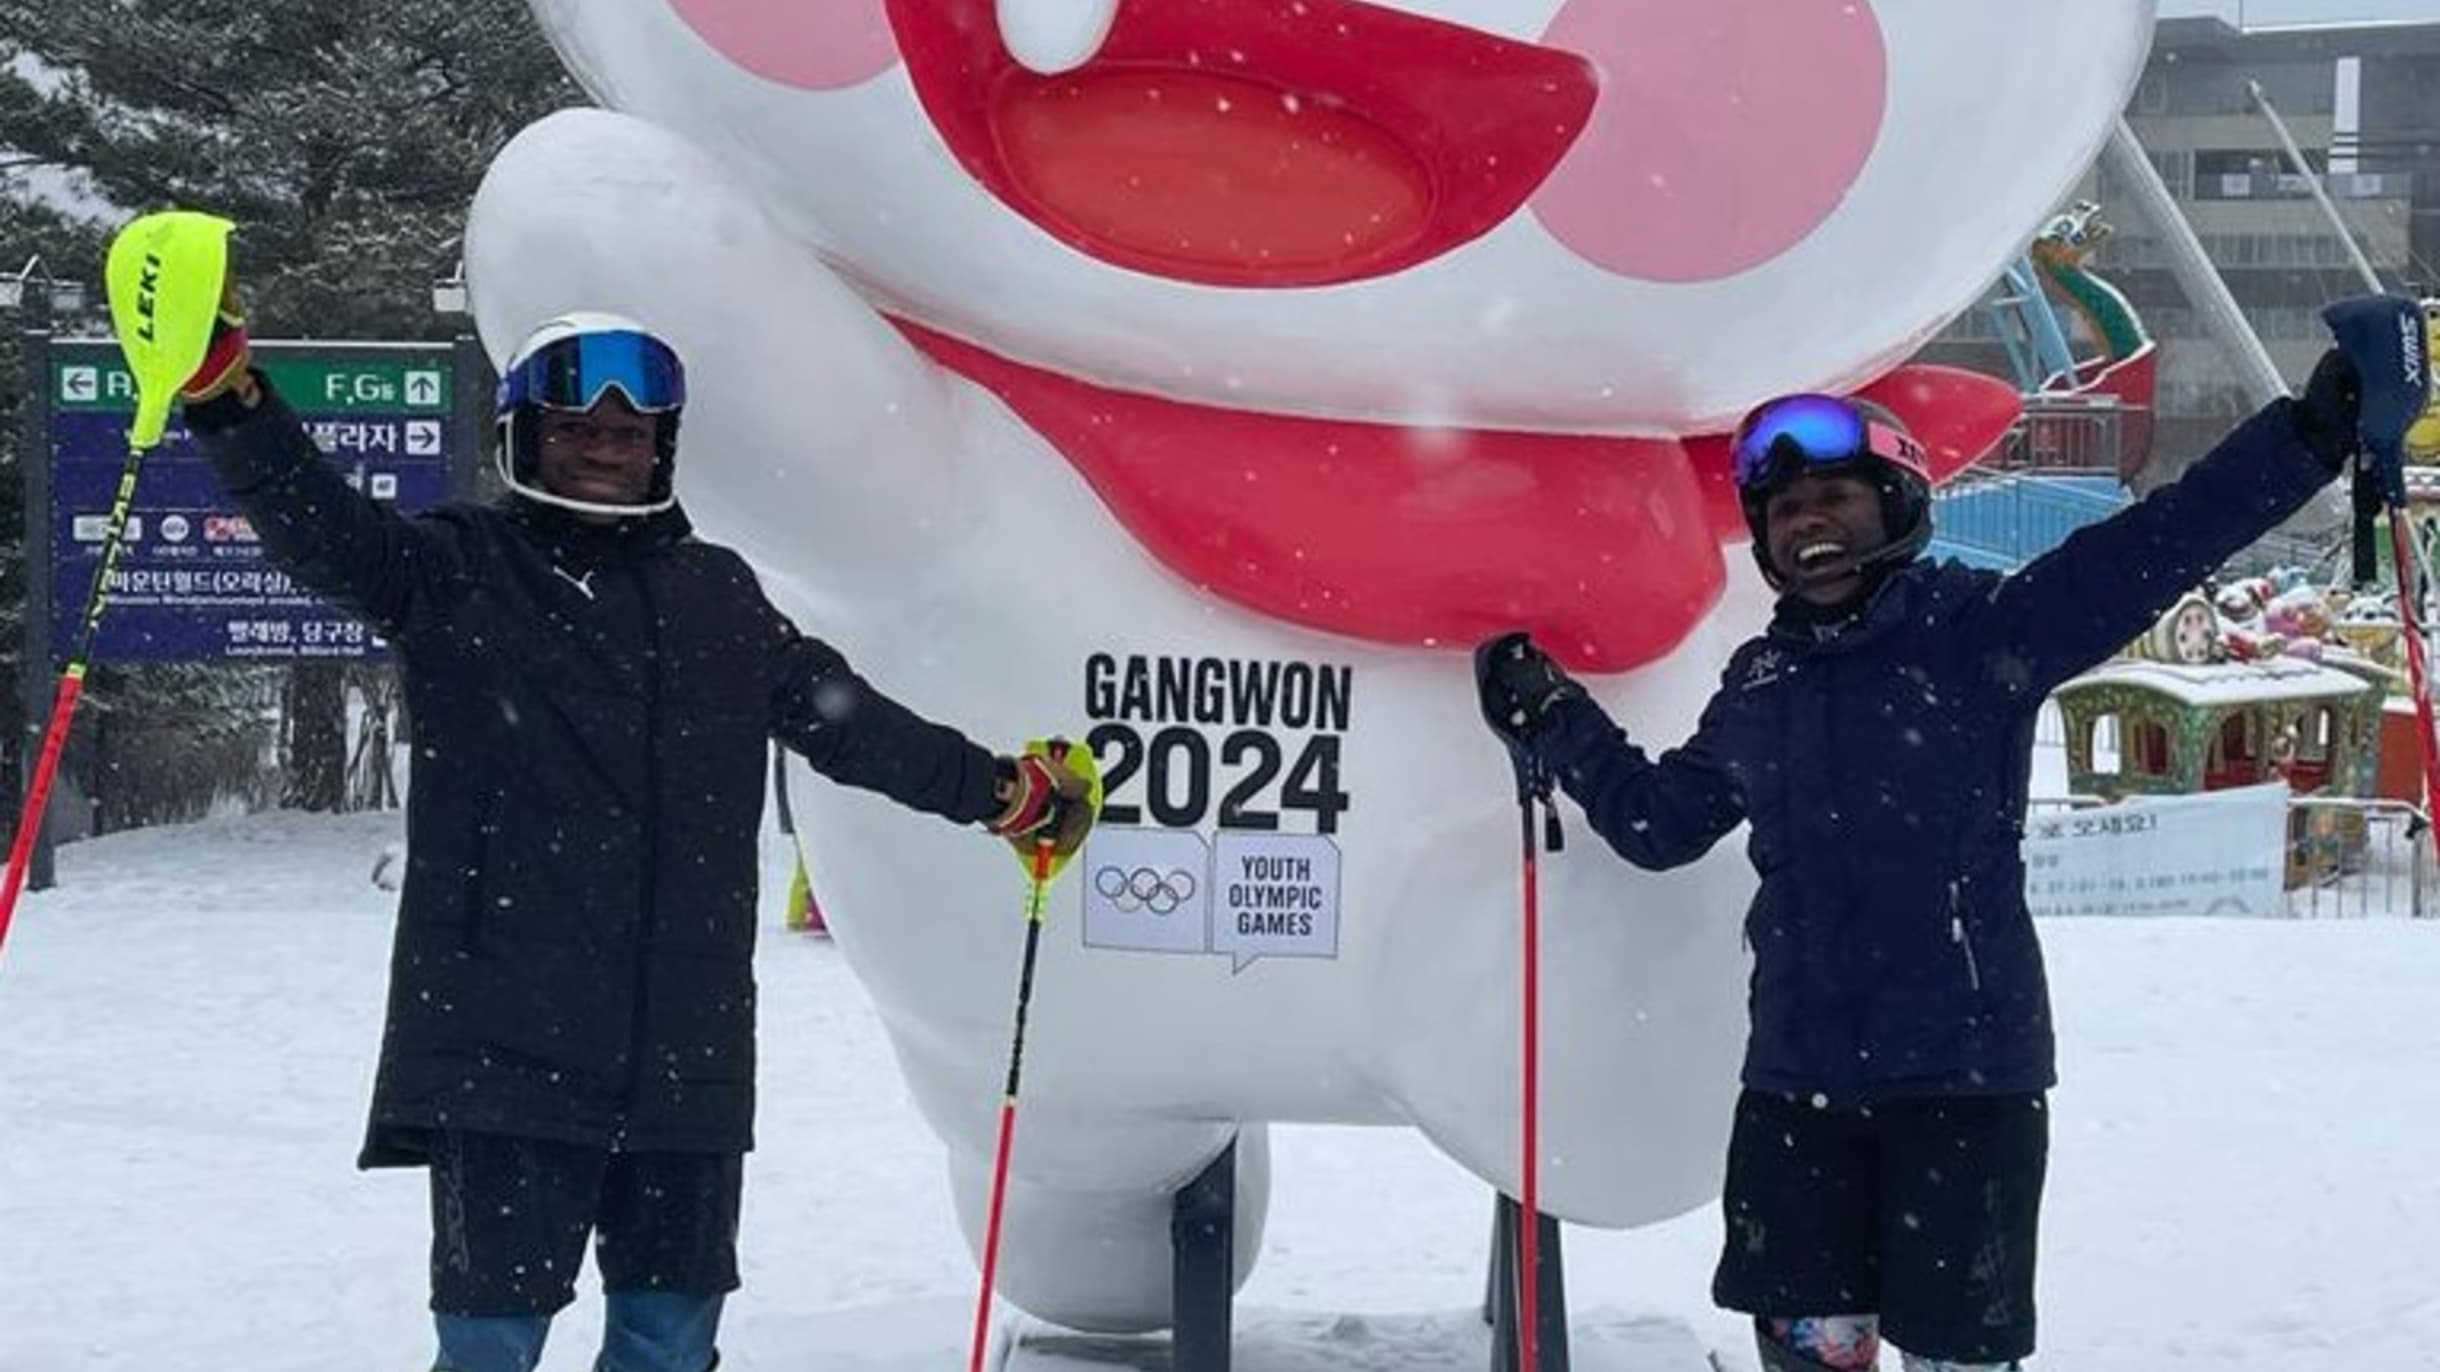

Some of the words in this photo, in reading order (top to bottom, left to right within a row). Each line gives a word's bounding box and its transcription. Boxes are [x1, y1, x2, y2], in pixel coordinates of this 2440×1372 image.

[137, 253, 160, 342] LEKI
[302, 421, 397, 453] 플라자
[1085, 653, 1353, 731] GANGWON
[1086, 723, 1349, 834] 2024
[1241, 856, 1310, 882] YOUTH
[1228, 883, 1323, 910] OLYMPIC
[1237, 912, 1312, 936] GAMES
